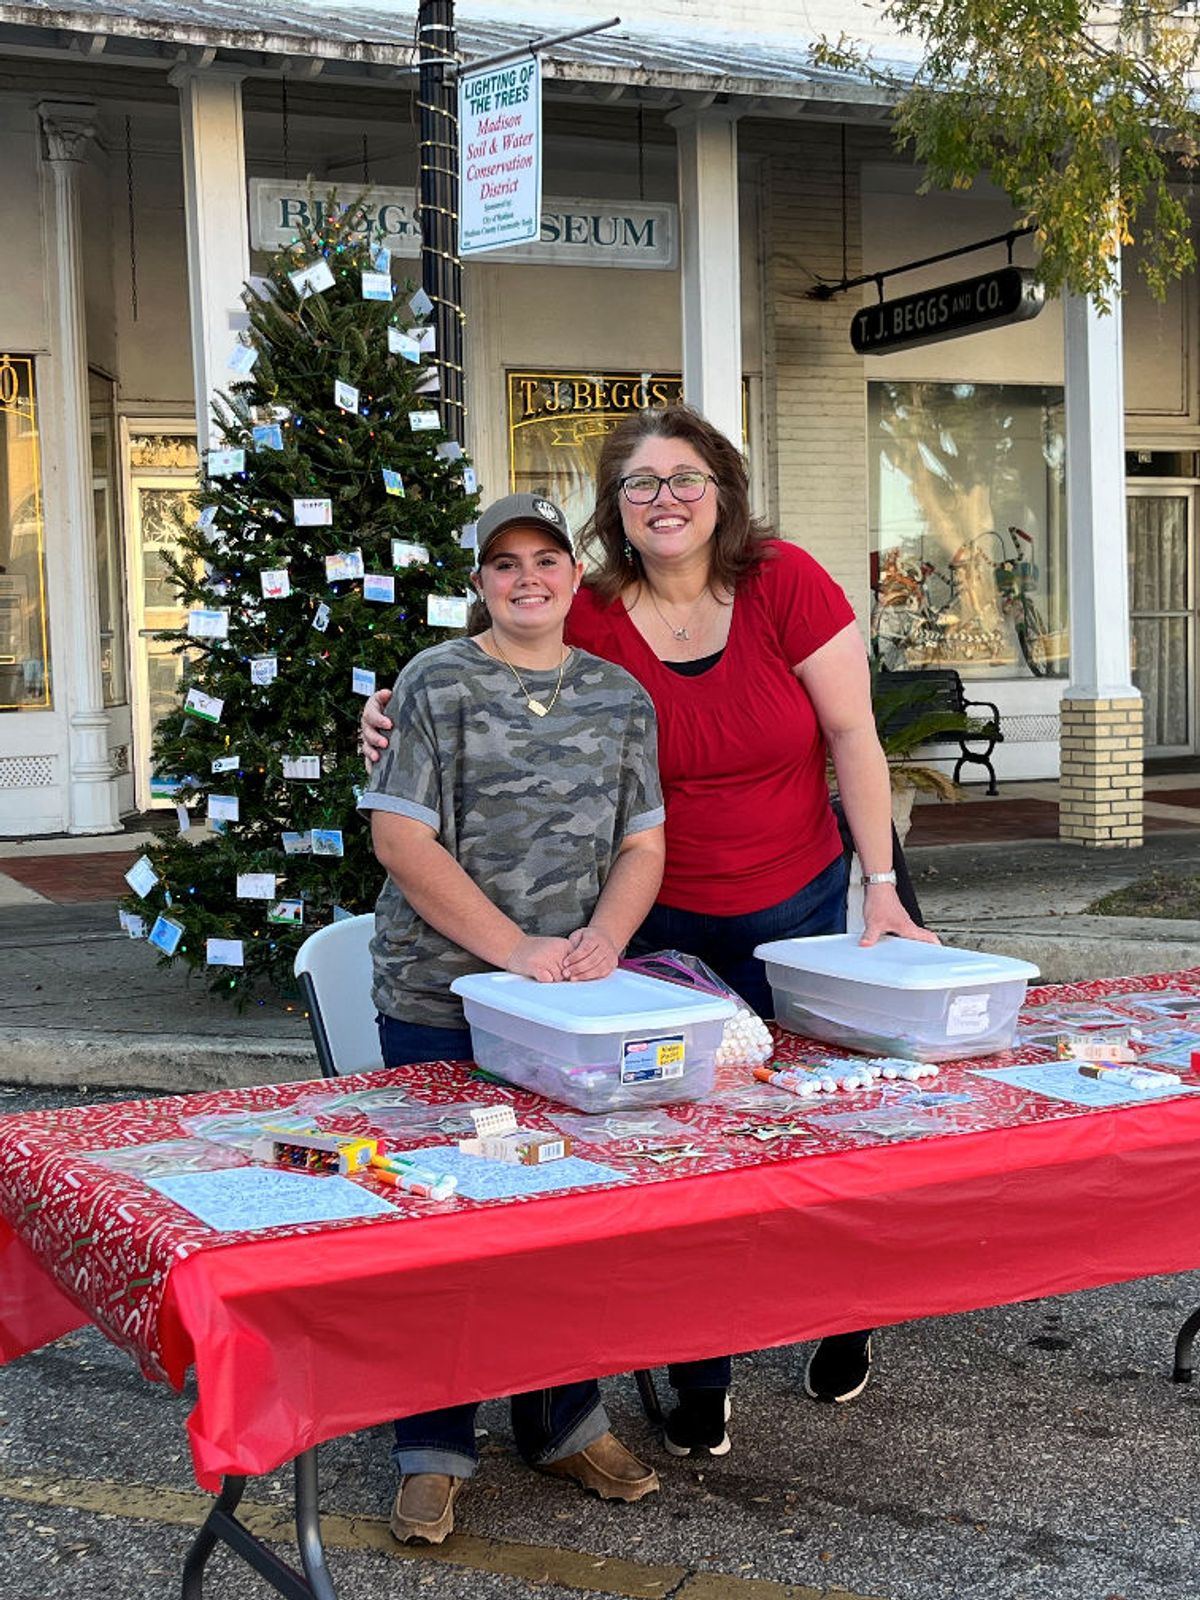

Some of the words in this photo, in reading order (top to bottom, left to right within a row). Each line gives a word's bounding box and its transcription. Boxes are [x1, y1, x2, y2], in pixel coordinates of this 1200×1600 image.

[465, 70, 516, 99] LIGHTING
[520, 65, 534, 83] OF
[470, 95, 491, 116] THE
[495, 84, 529, 110] TREES
[477, 115, 522, 137] Madison
[467, 140, 487, 160] Soil
[489, 137, 498, 155] &
[503, 133, 534, 151] Water
[467, 154, 533, 182] Conservation
[480, 178, 519, 200] District
[540, 212, 656, 247] SEUM
[894, 294, 948, 334] BEGGS
[952, 294, 971, 314] AND
[976, 280, 1003, 312] CO.
[573, 382, 668, 410] BEGGS
